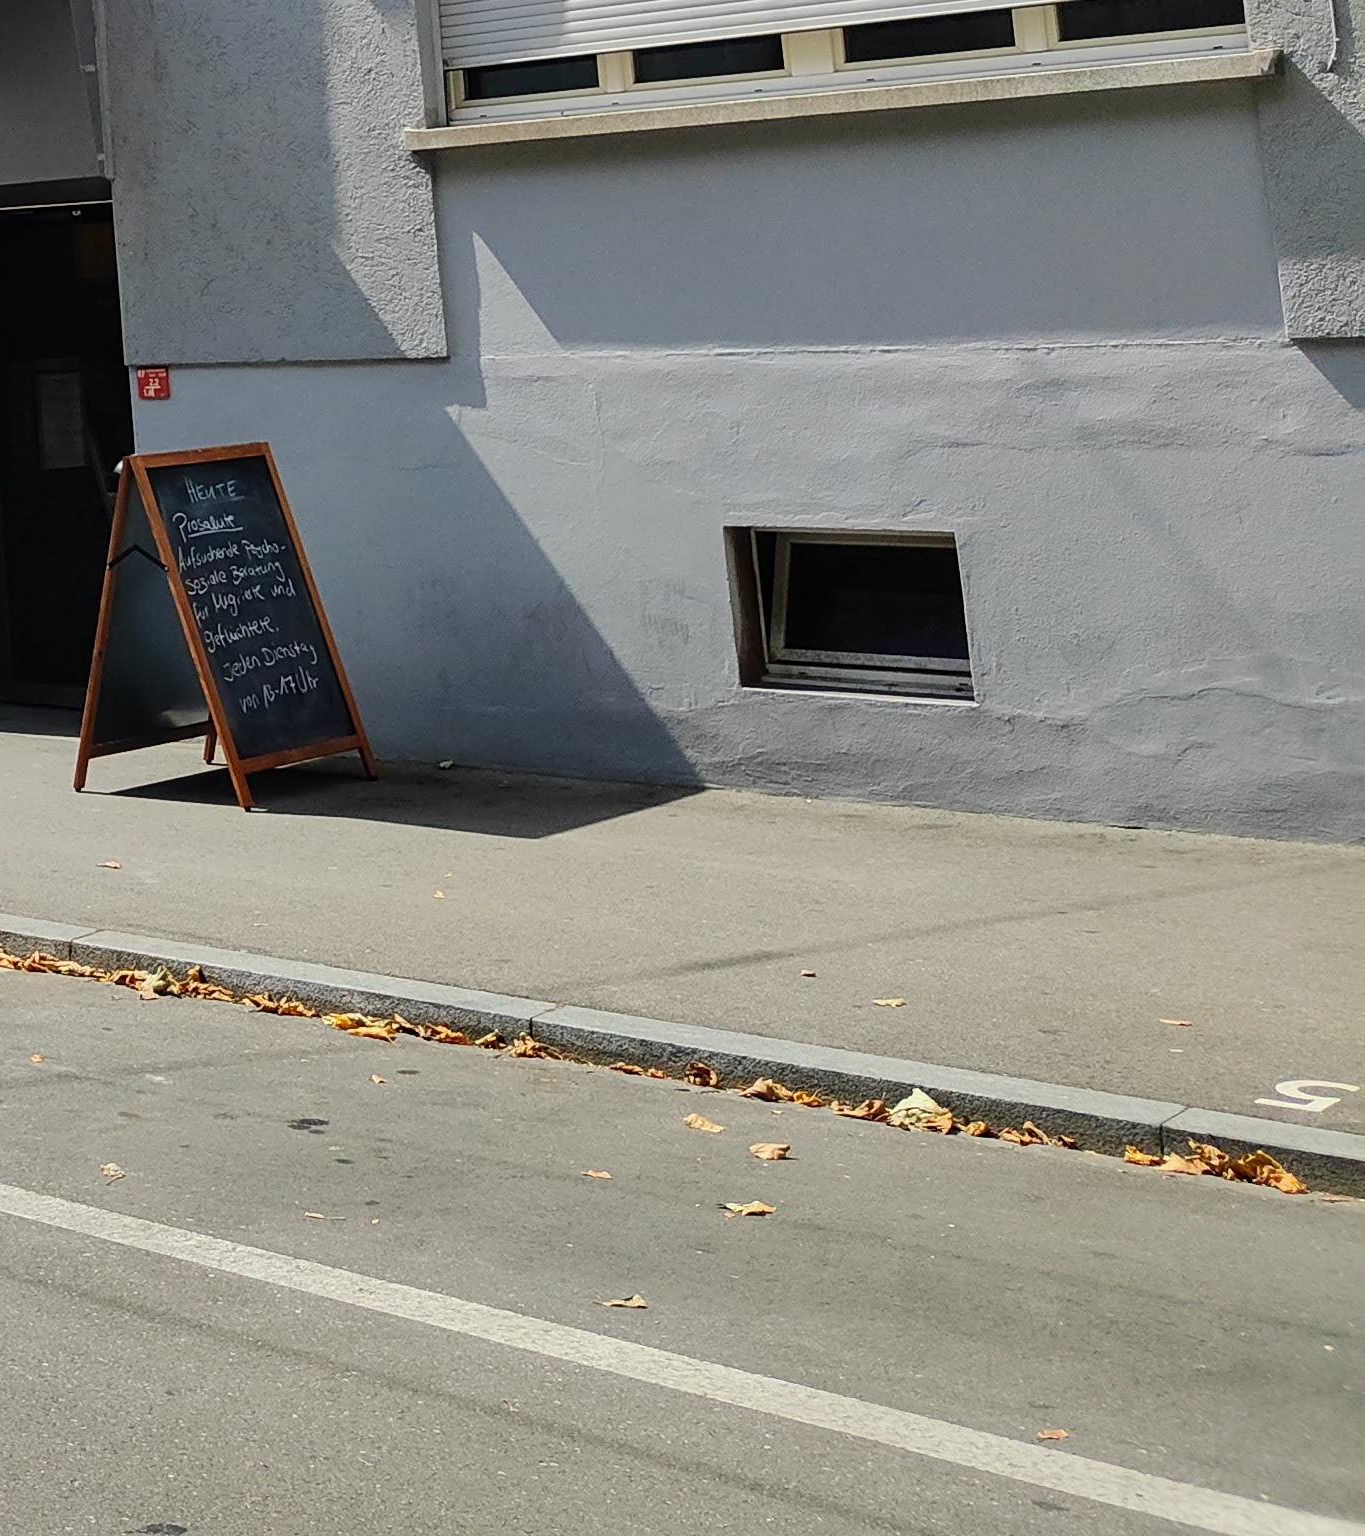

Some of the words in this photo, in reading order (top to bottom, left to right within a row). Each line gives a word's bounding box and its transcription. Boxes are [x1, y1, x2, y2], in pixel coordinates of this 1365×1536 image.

[184, 477, 237, 504] HEUTE
[270, 578, 297, 598] und
[261, 641, 318, 666] Dienstag
[239, 693, 260, 714] von
